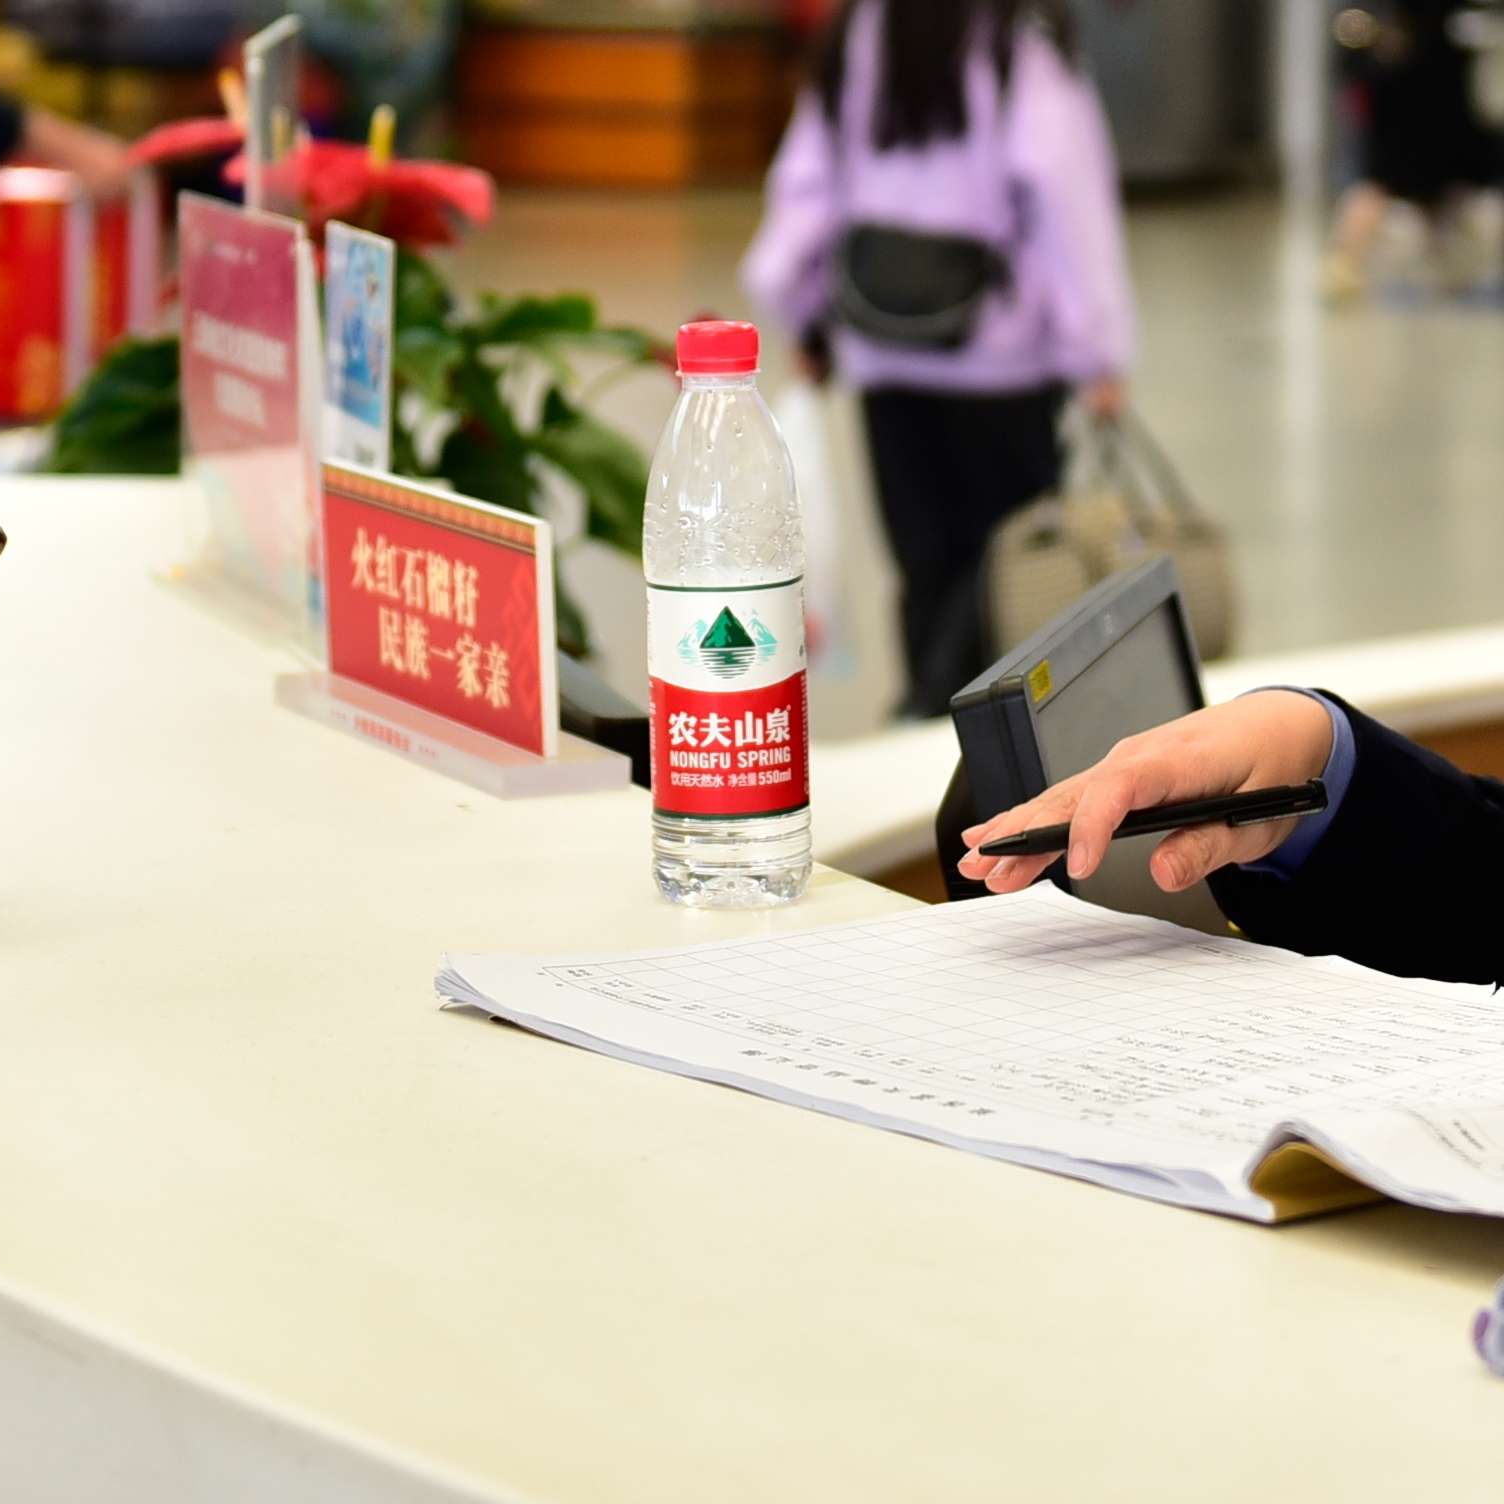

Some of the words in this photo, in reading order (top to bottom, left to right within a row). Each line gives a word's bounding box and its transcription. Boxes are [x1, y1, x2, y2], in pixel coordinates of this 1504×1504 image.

[378, 606, 511, 710] 民族一家亲
[668, 708, 790, 748] 农夫山泉
[670, 750, 731, 769] NONGFU
[737, 746, 791, 768] SPRING
[670, 771, 724, 788] 饮用天然水
